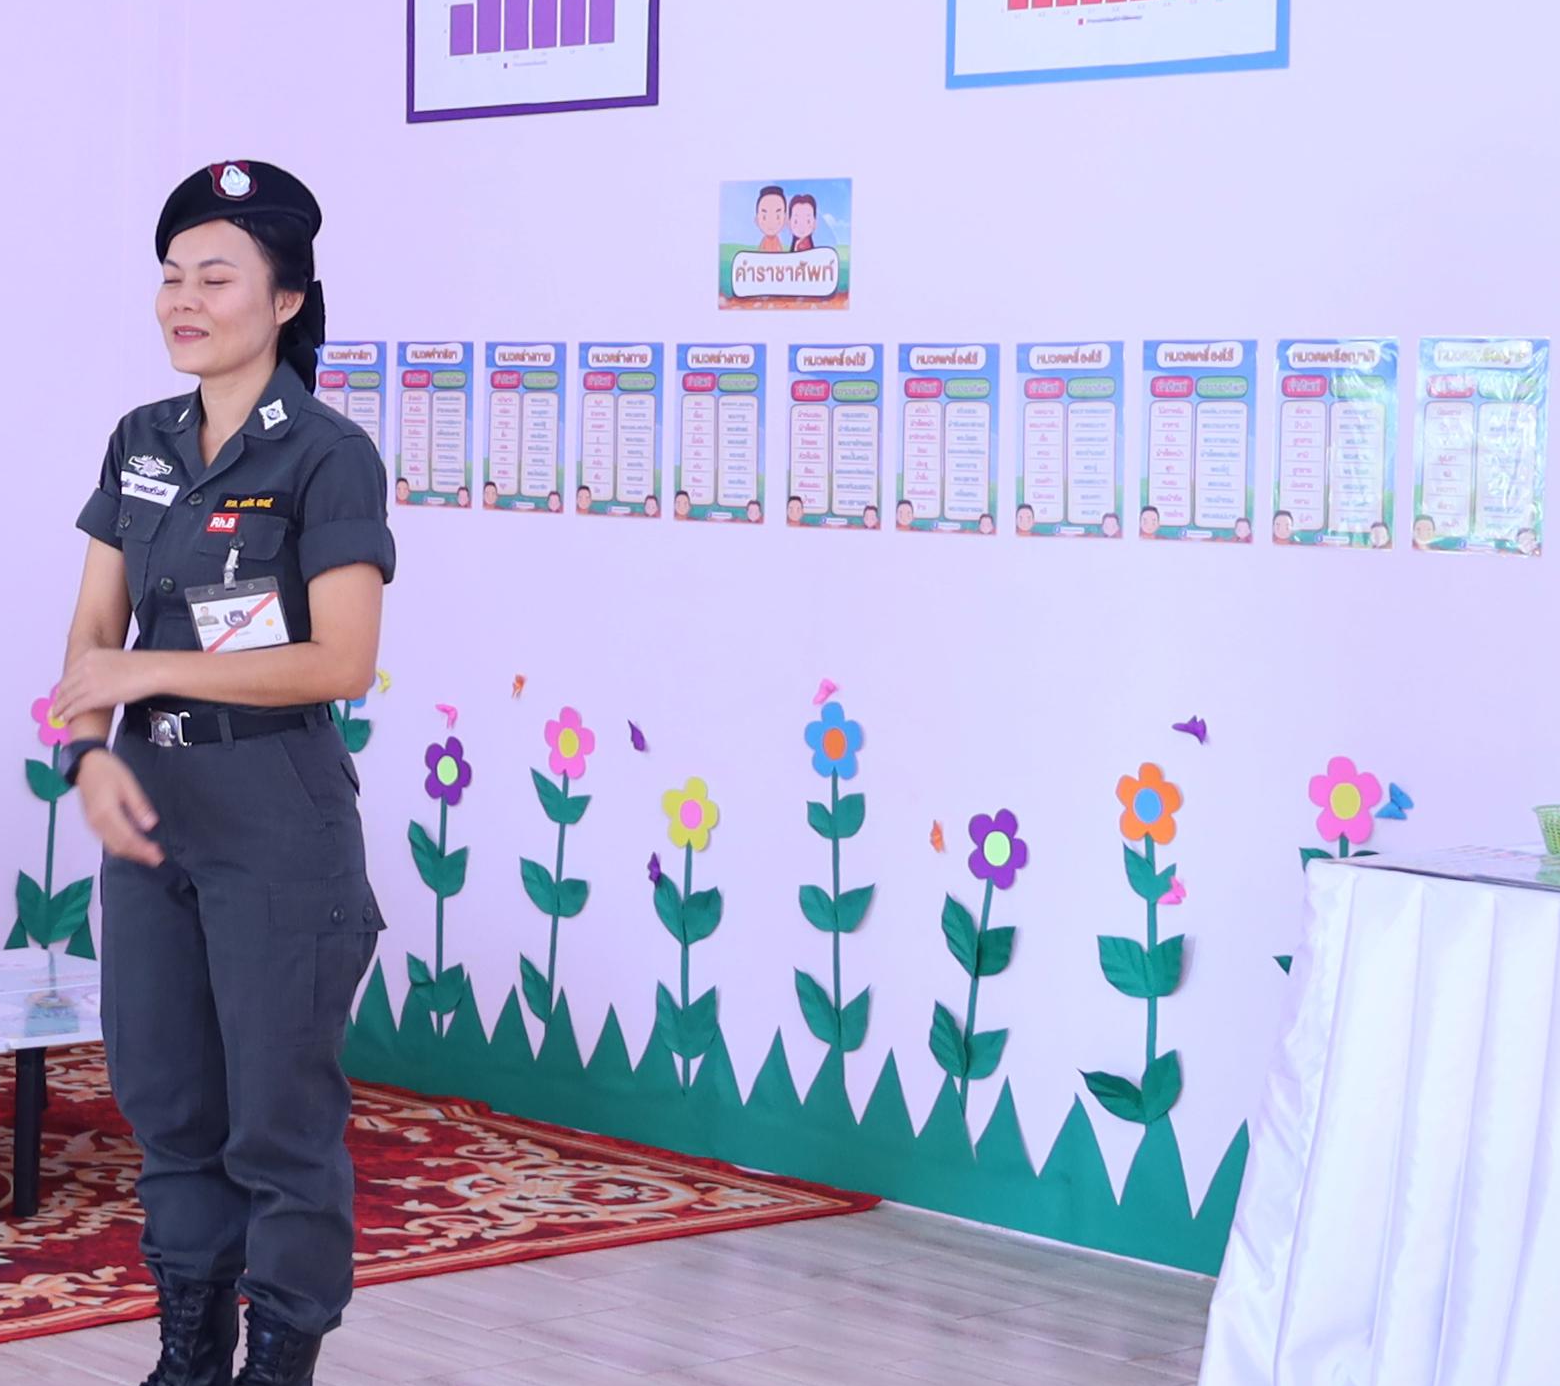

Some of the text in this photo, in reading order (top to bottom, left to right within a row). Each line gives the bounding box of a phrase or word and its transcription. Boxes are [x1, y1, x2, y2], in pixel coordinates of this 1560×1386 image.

[735, 259, 835, 282] คำราชาศัพท์
